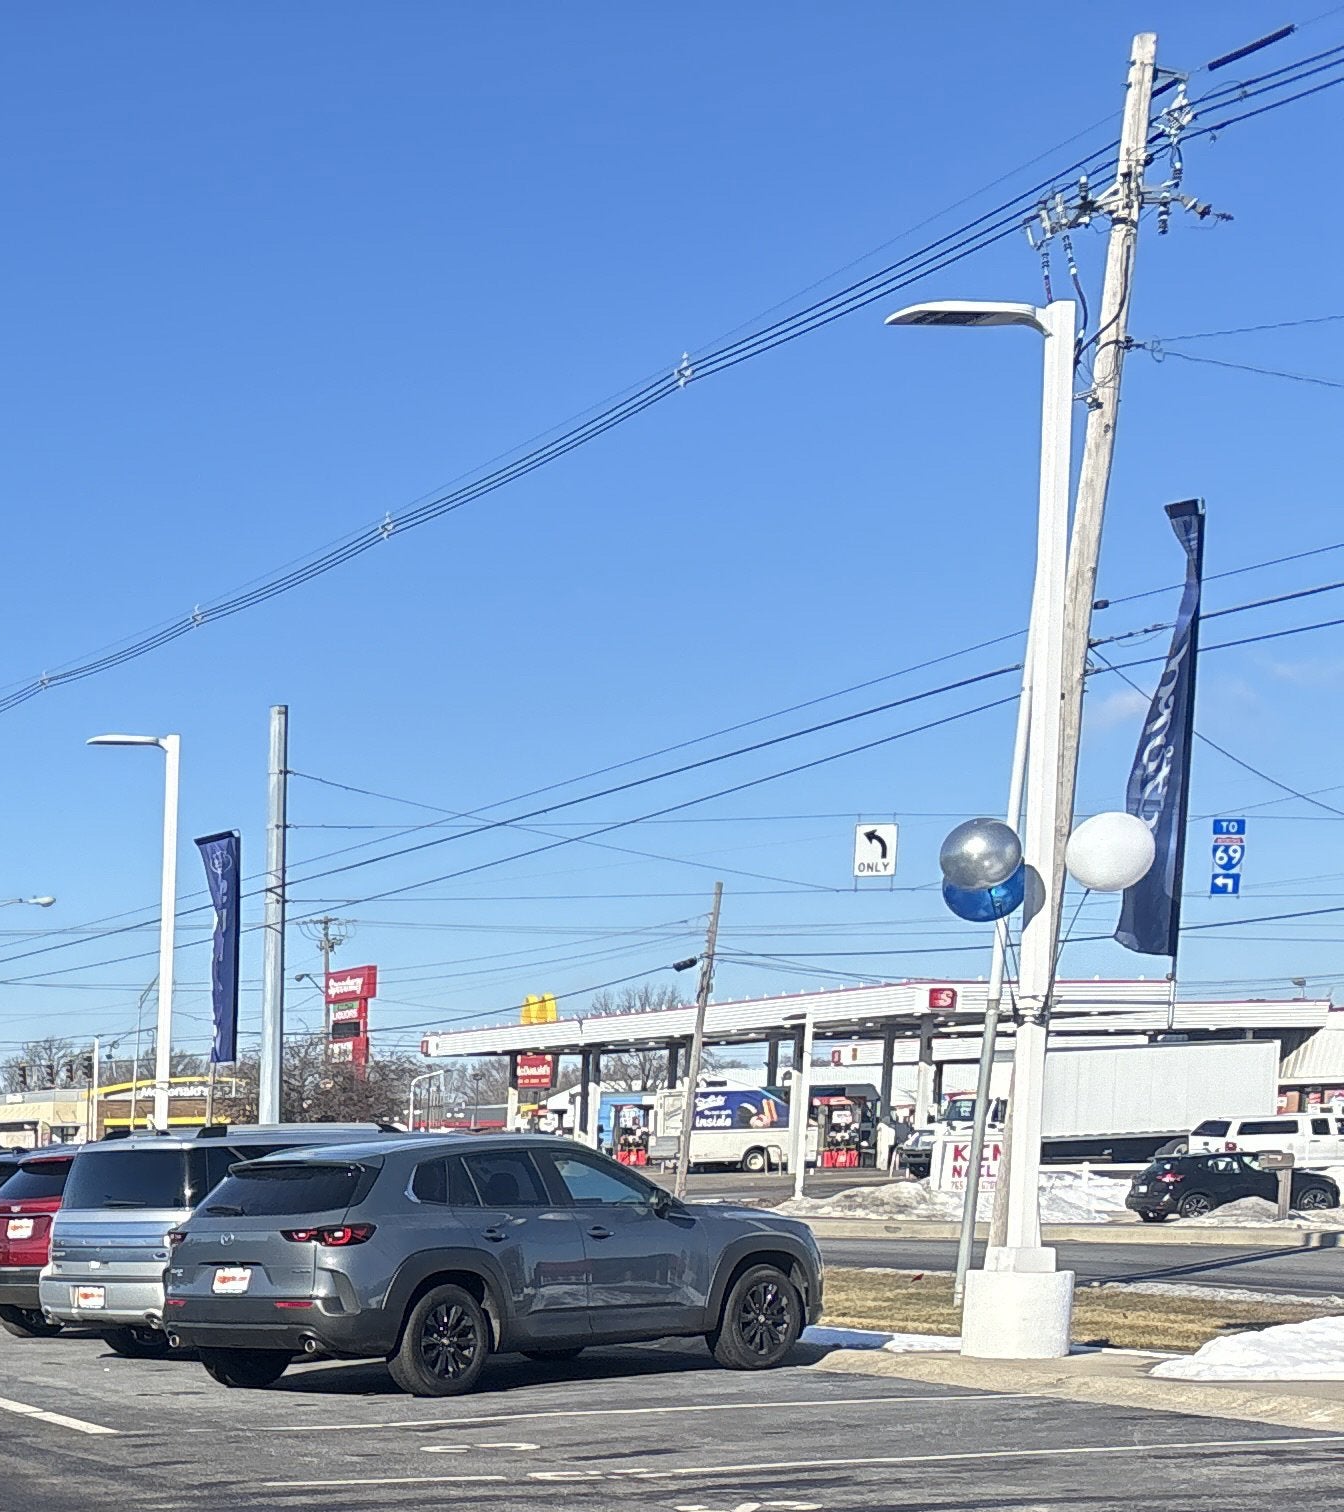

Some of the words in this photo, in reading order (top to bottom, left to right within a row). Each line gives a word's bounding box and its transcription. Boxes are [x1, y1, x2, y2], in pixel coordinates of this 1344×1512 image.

[1220, 822, 1238, 833] TO
[1215, 845, 1242, 865] 69
[857, 861, 890, 873] ONLY
